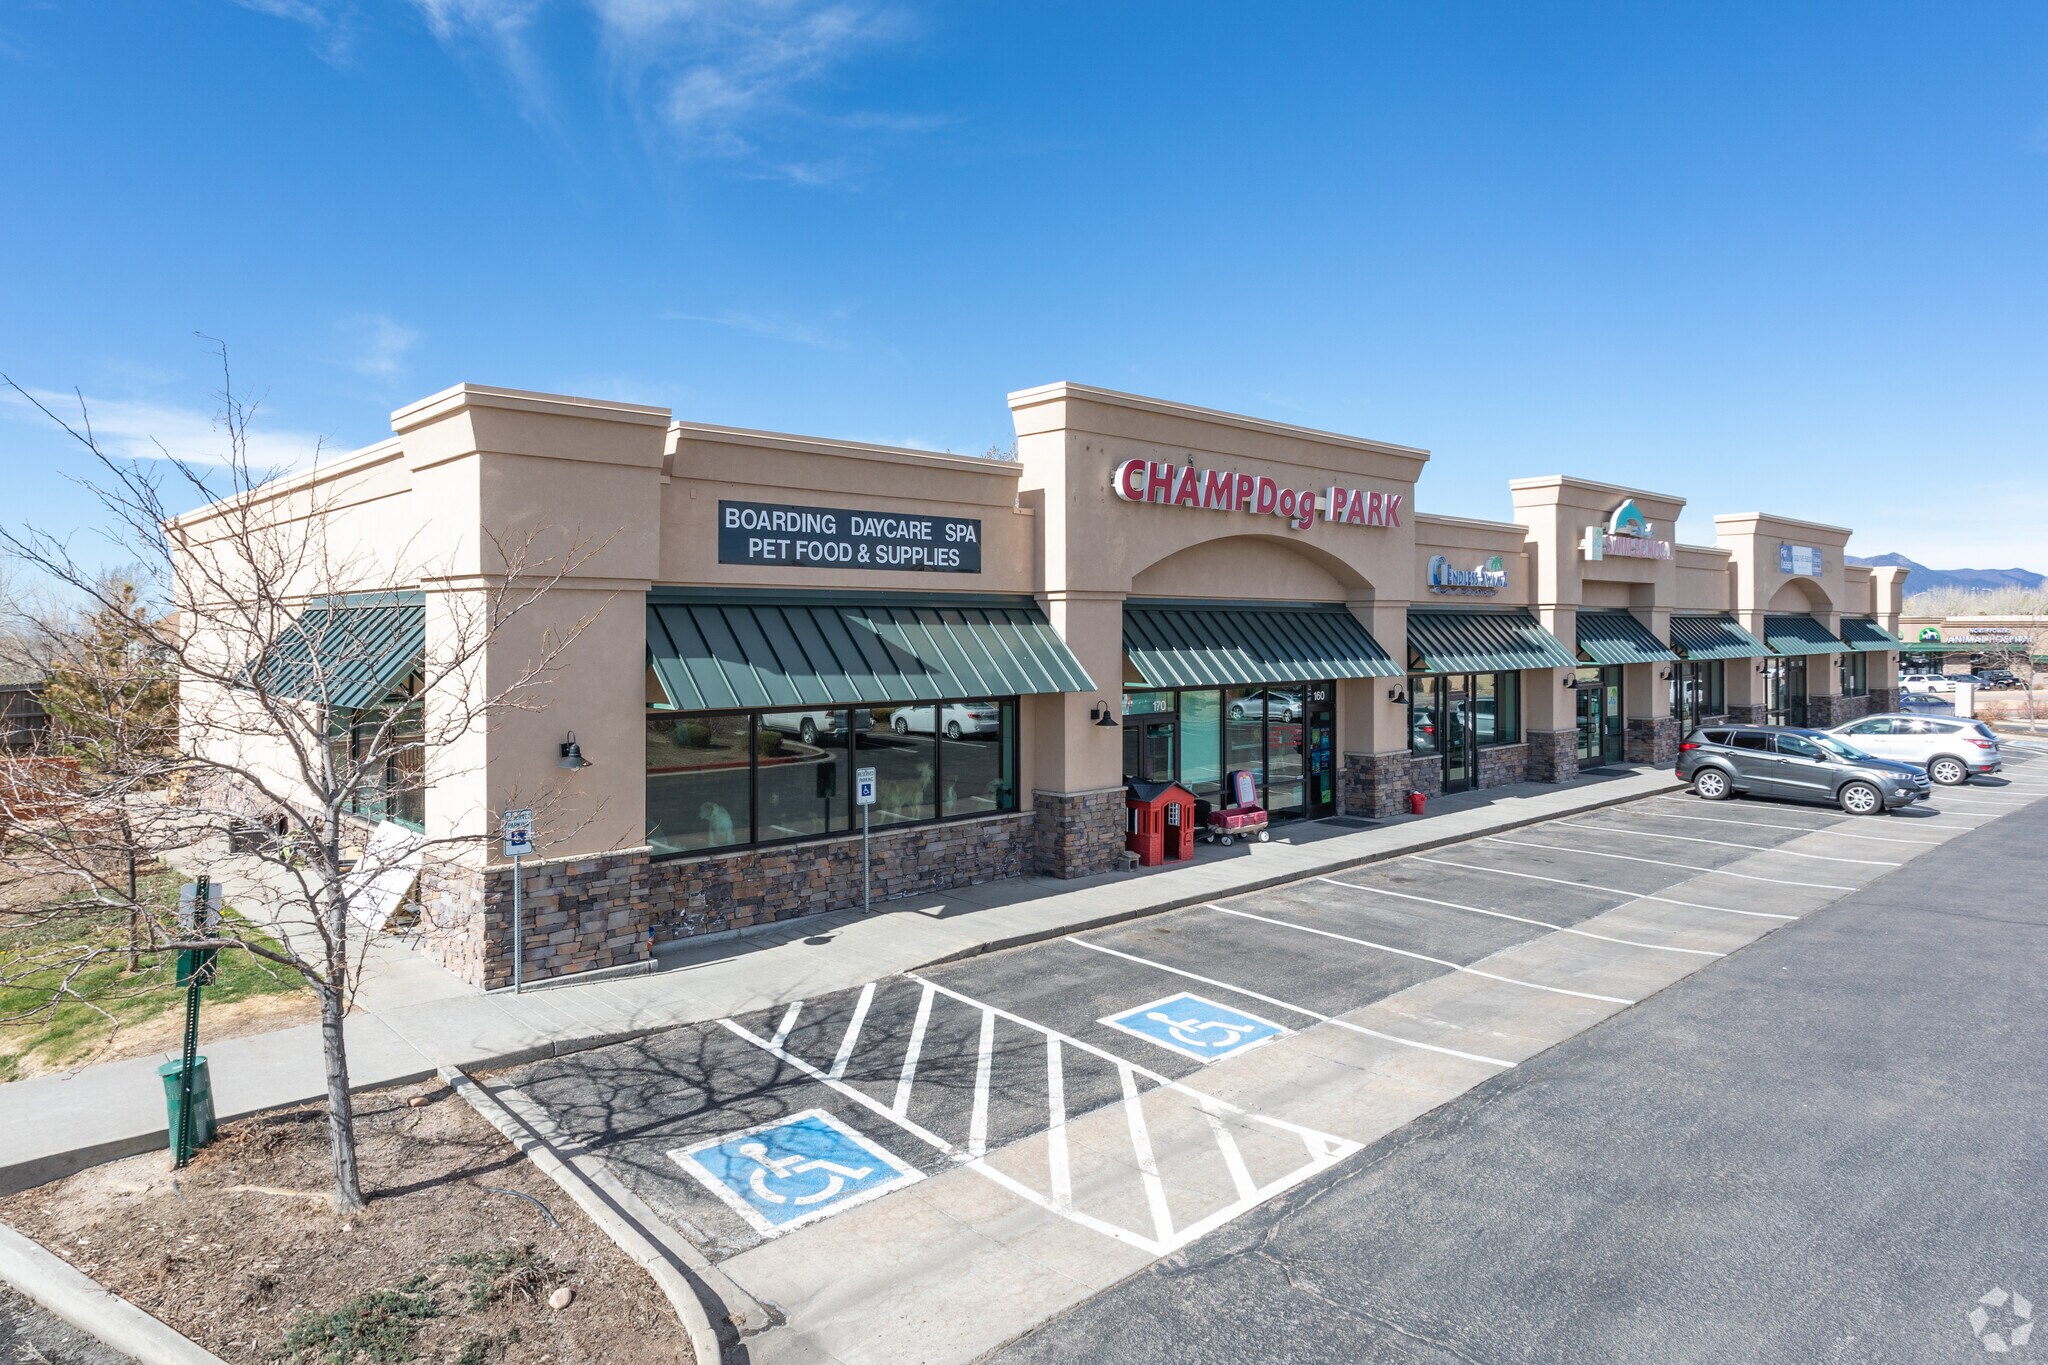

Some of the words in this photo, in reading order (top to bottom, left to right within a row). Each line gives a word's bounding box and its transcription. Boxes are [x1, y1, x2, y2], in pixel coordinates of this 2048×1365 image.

[1325, 486, 1402, 528] PARK
[725, 507, 836, 535] BOARDING
[851, 516, 932, 541] DAYCARE
[945, 523, 977, 543] SPA
[749, 537, 790, 560] PET
[796, 541, 852, 562] FOOD
[858, 545, 870, 563] &
[875, 545, 960, 567] SUPPLIES
[1605, 534, 1632, 556] SWIM
[1634, 538, 1674, 560] SCHOOL
[1443, 564, 1478, 586] ENDLESS
[1948, 635, 1985, 643] ANIMAL
[1989, 635, 2033, 644] HOSPITAL
[1153, 700, 1167, 711] 170
[1313, 690, 1325, 701] 160
